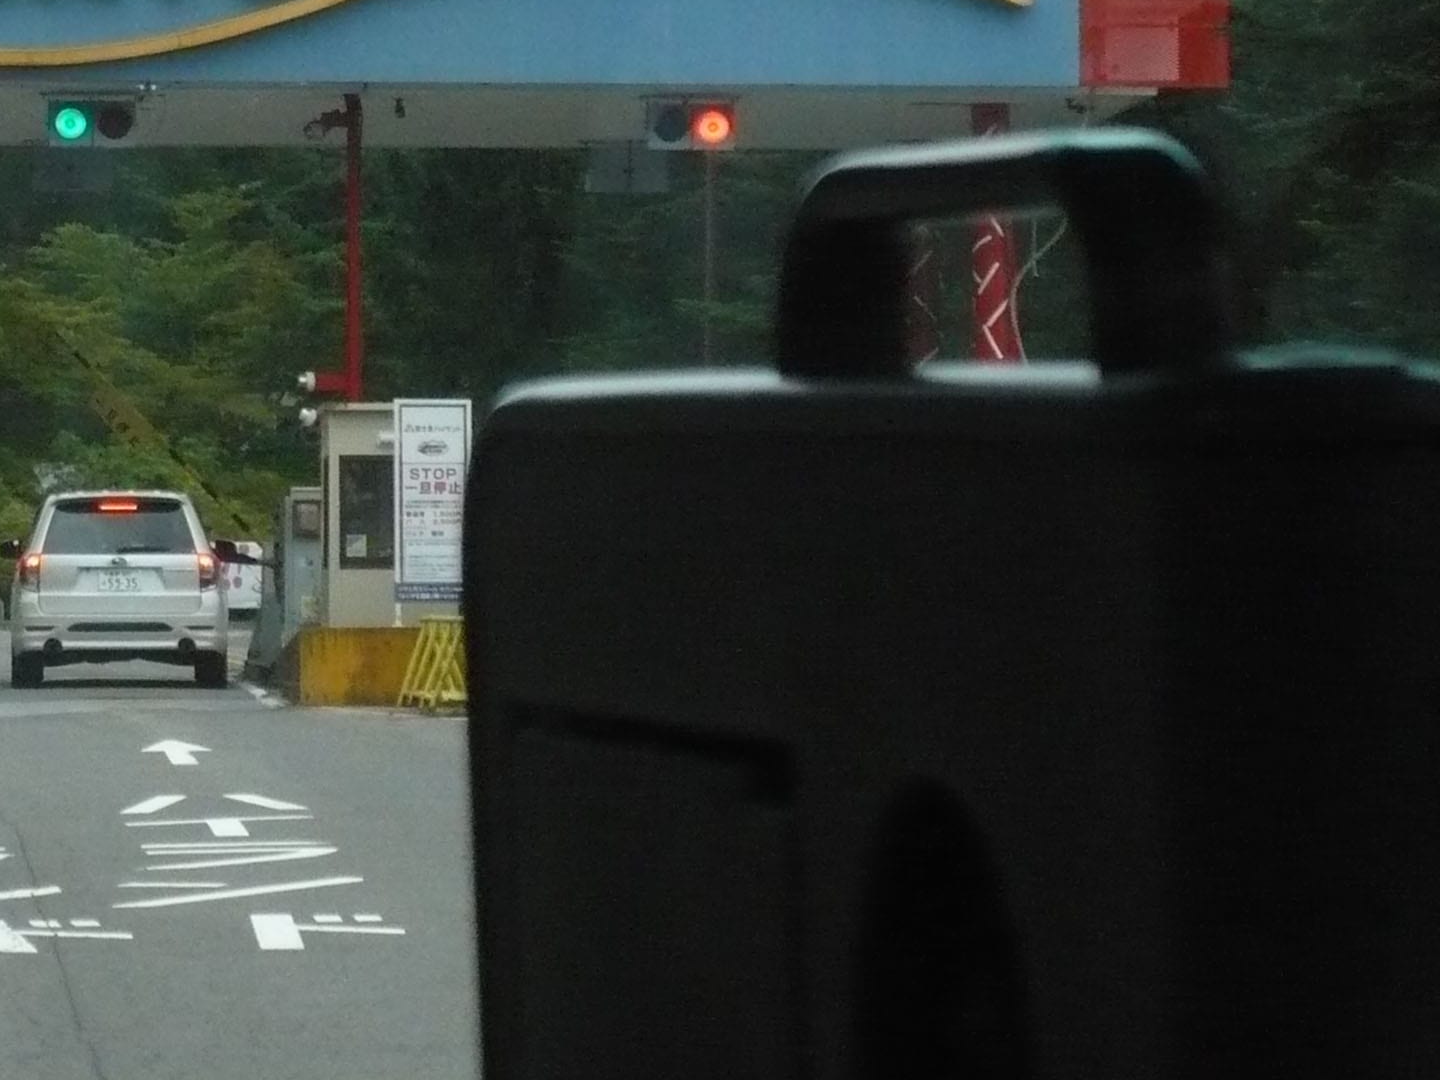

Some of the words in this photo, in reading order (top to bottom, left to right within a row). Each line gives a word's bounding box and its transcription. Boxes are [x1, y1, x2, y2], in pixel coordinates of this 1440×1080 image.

[409, 467, 457, 480] STOP
[405, 481, 462, 495] 一旦停止
